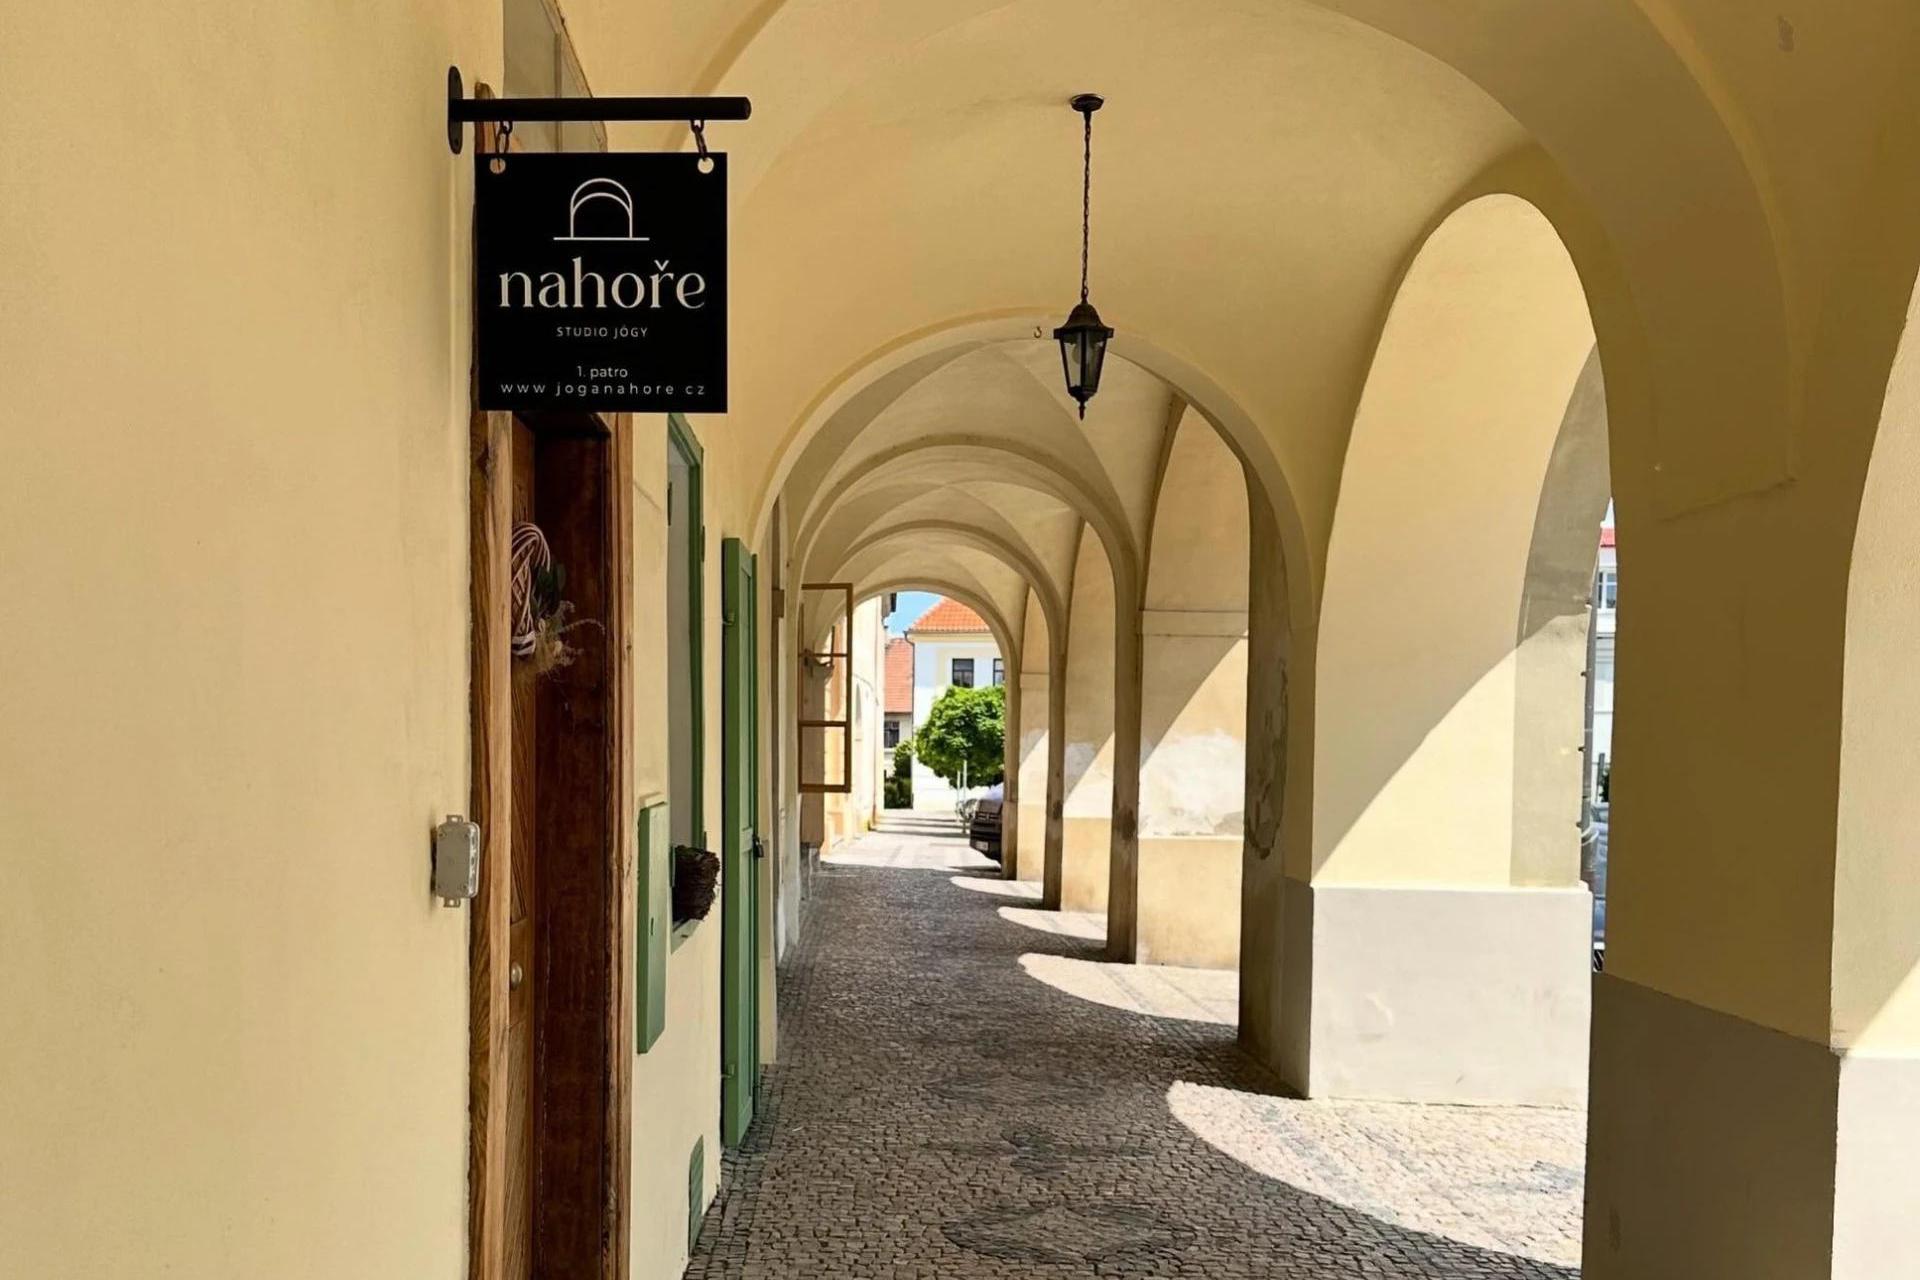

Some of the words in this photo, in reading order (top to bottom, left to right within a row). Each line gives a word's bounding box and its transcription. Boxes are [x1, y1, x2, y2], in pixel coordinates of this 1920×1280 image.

[499, 256, 706, 309] nahoře
[556, 326, 608, 337] STUDIO
[613, 324, 648, 340] JÓGY
[577, 365, 586, 378] 1.
[590, 367, 628, 381] patro
